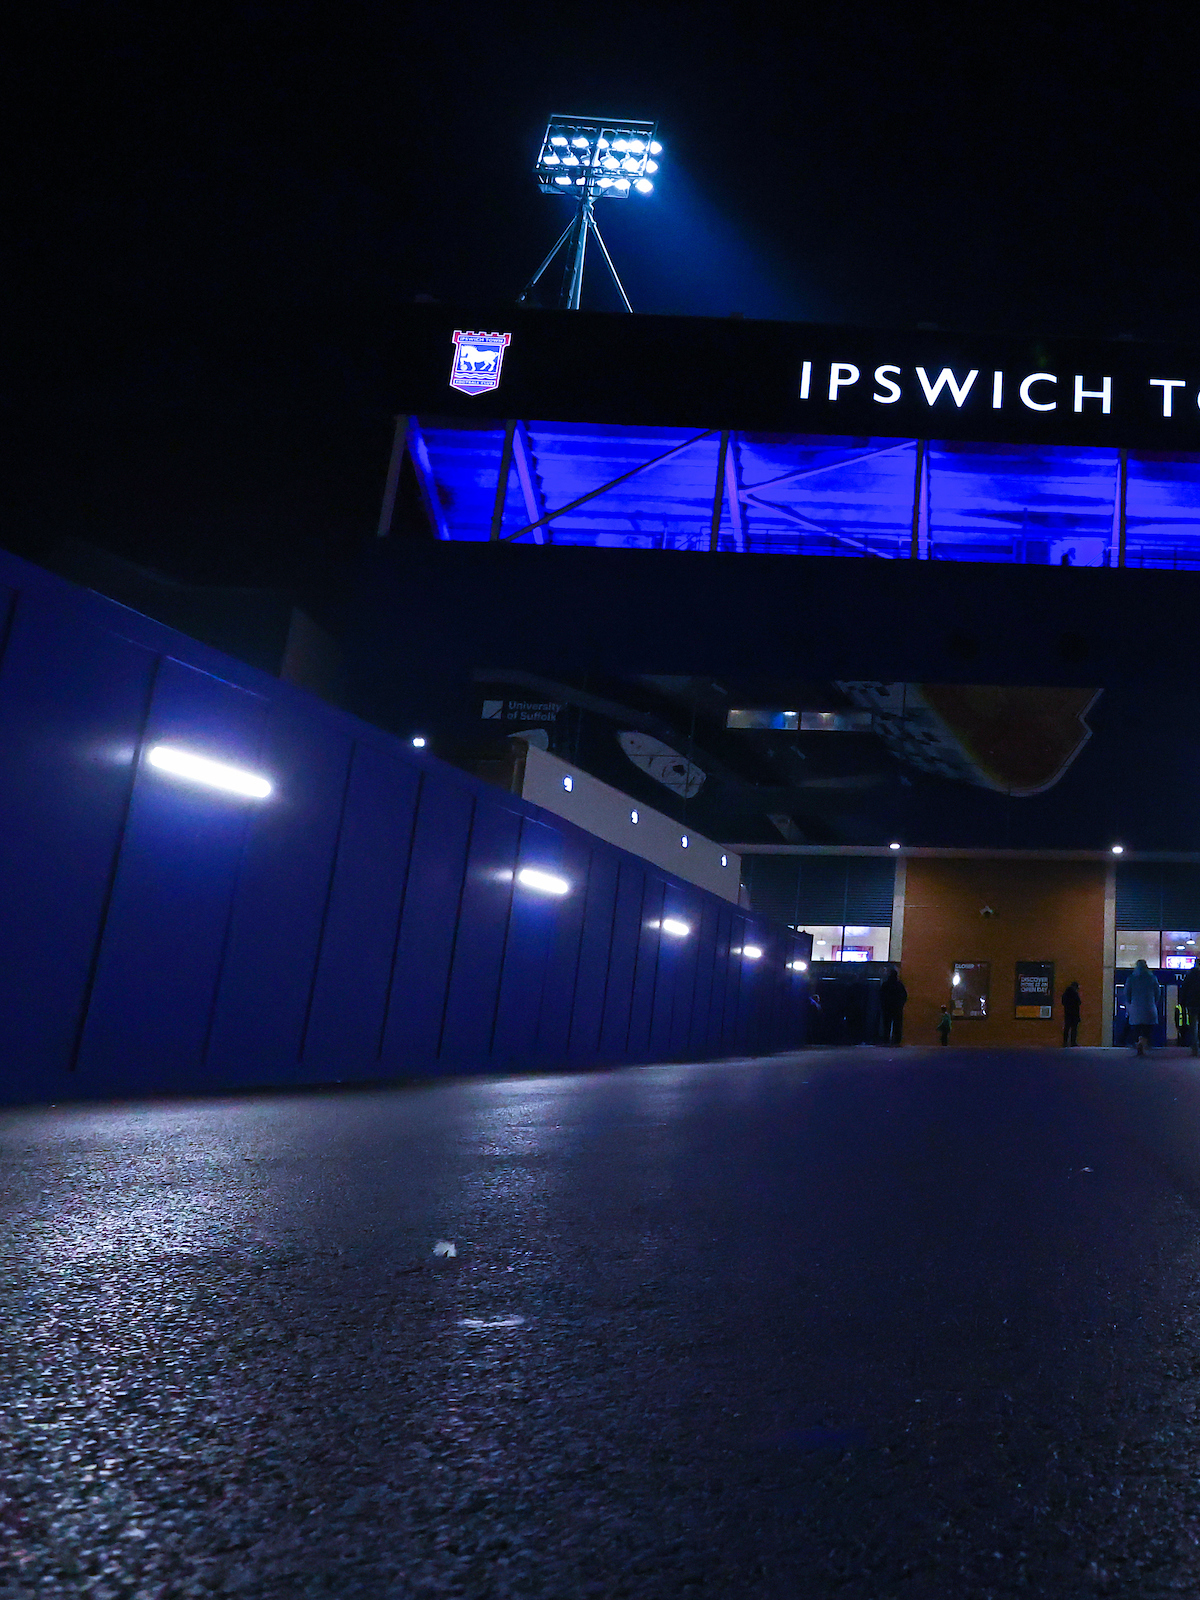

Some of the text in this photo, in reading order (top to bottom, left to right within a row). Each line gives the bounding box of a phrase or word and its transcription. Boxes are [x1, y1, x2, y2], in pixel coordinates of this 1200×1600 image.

[800, 361, 1114, 414] IPSWICH
[508, 701, 561, 712] University
[507, 711, 557, 721] of Suffolk
